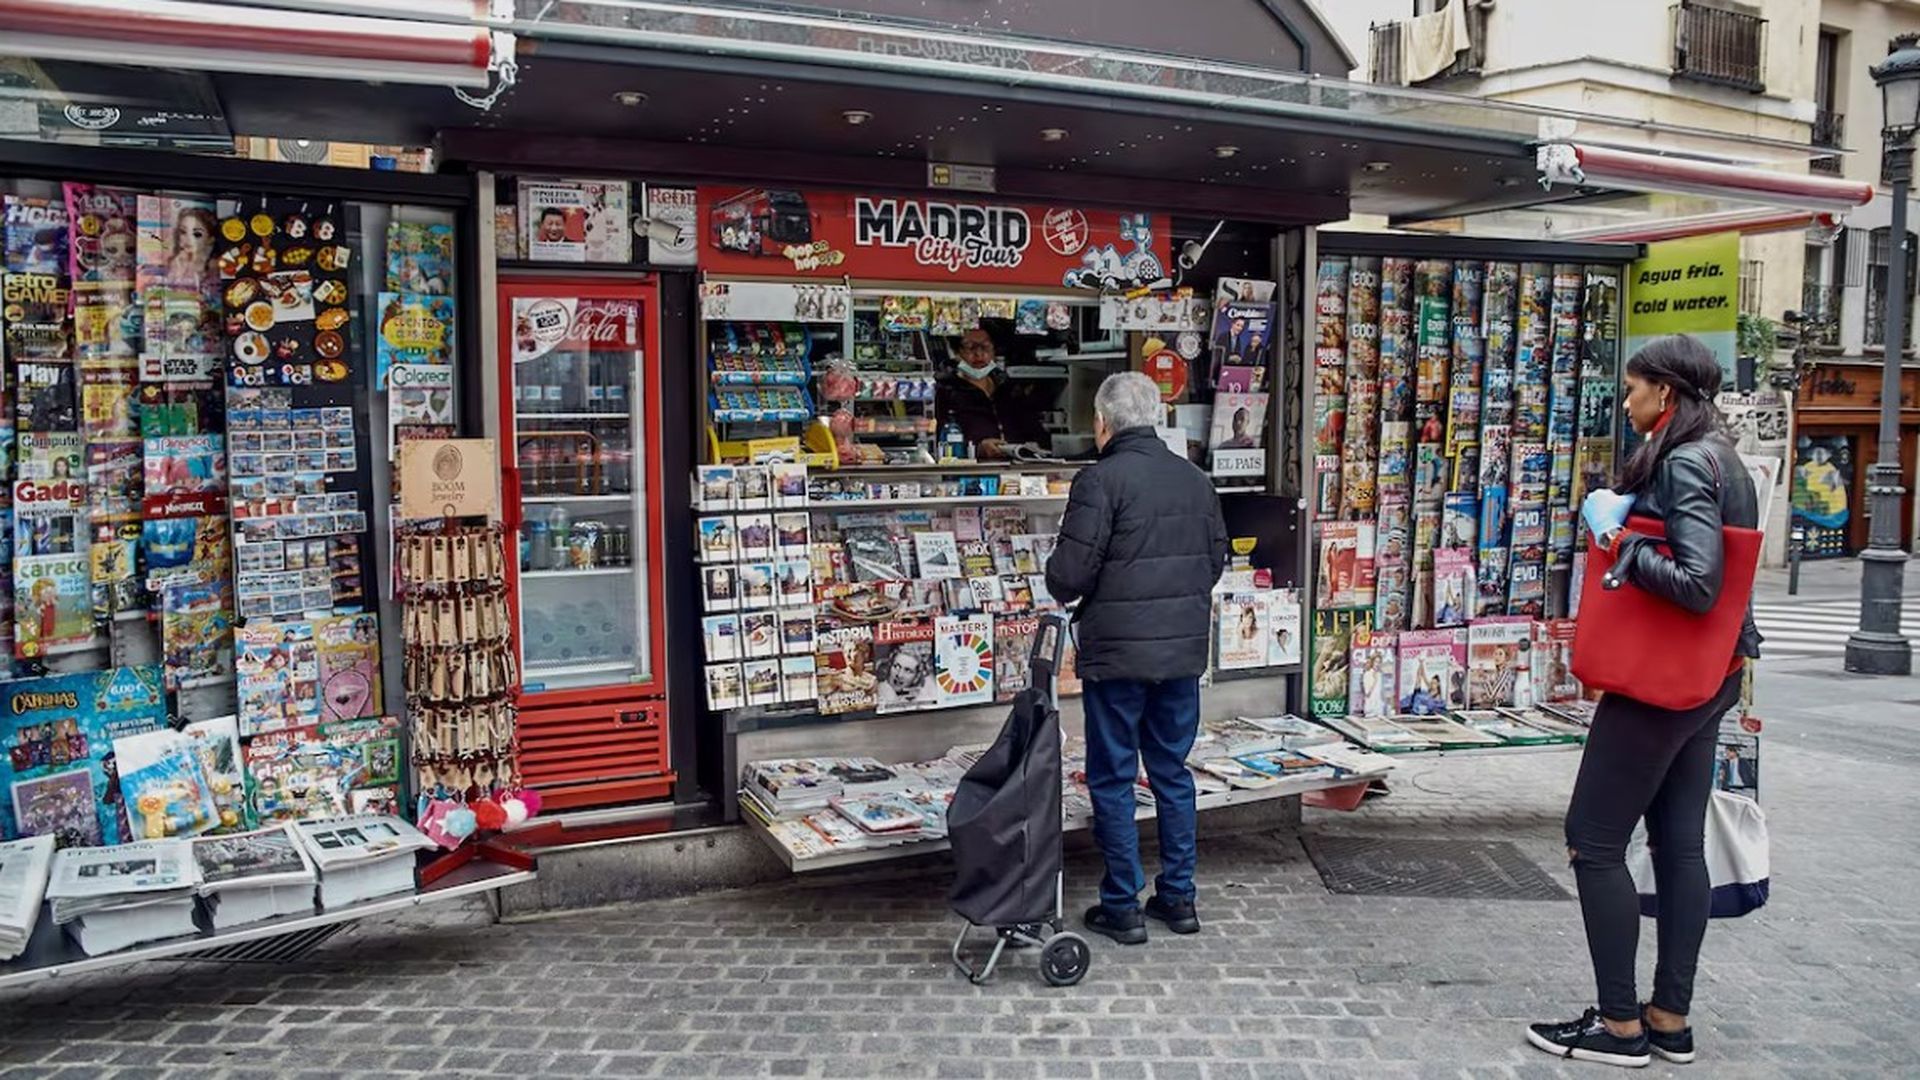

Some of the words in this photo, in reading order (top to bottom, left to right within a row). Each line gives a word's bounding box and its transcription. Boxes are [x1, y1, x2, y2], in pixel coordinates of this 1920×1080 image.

[856, 198, 1031, 251] MADRID
[915, 235, 967, 272] City
[965, 238, 1022, 268] Tour
[795, 255, 820, 271] hop
[3, 273, 57, 290] retro
[1638, 267, 1682, 285] Agua
[1633, 299, 1667, 314] Cold
[1671, 294, 1730, 311] water.
[164, 365, 198, 376] WARS
[165, 358, 197, 368] STAR
[18, 363, 60, 386] Play
[391, 365, 450, 387] Colorear
[1216, 457, 1235, 470] EL
[1235, 454, 1263, 469] PAÍS
[431, 482, 466, 492] BOOM
[940, 622, 988, 634] MASTERS
[1315, 610, 1374, 636] ELLE
[813, 624, 874, 646] HISTORIA
